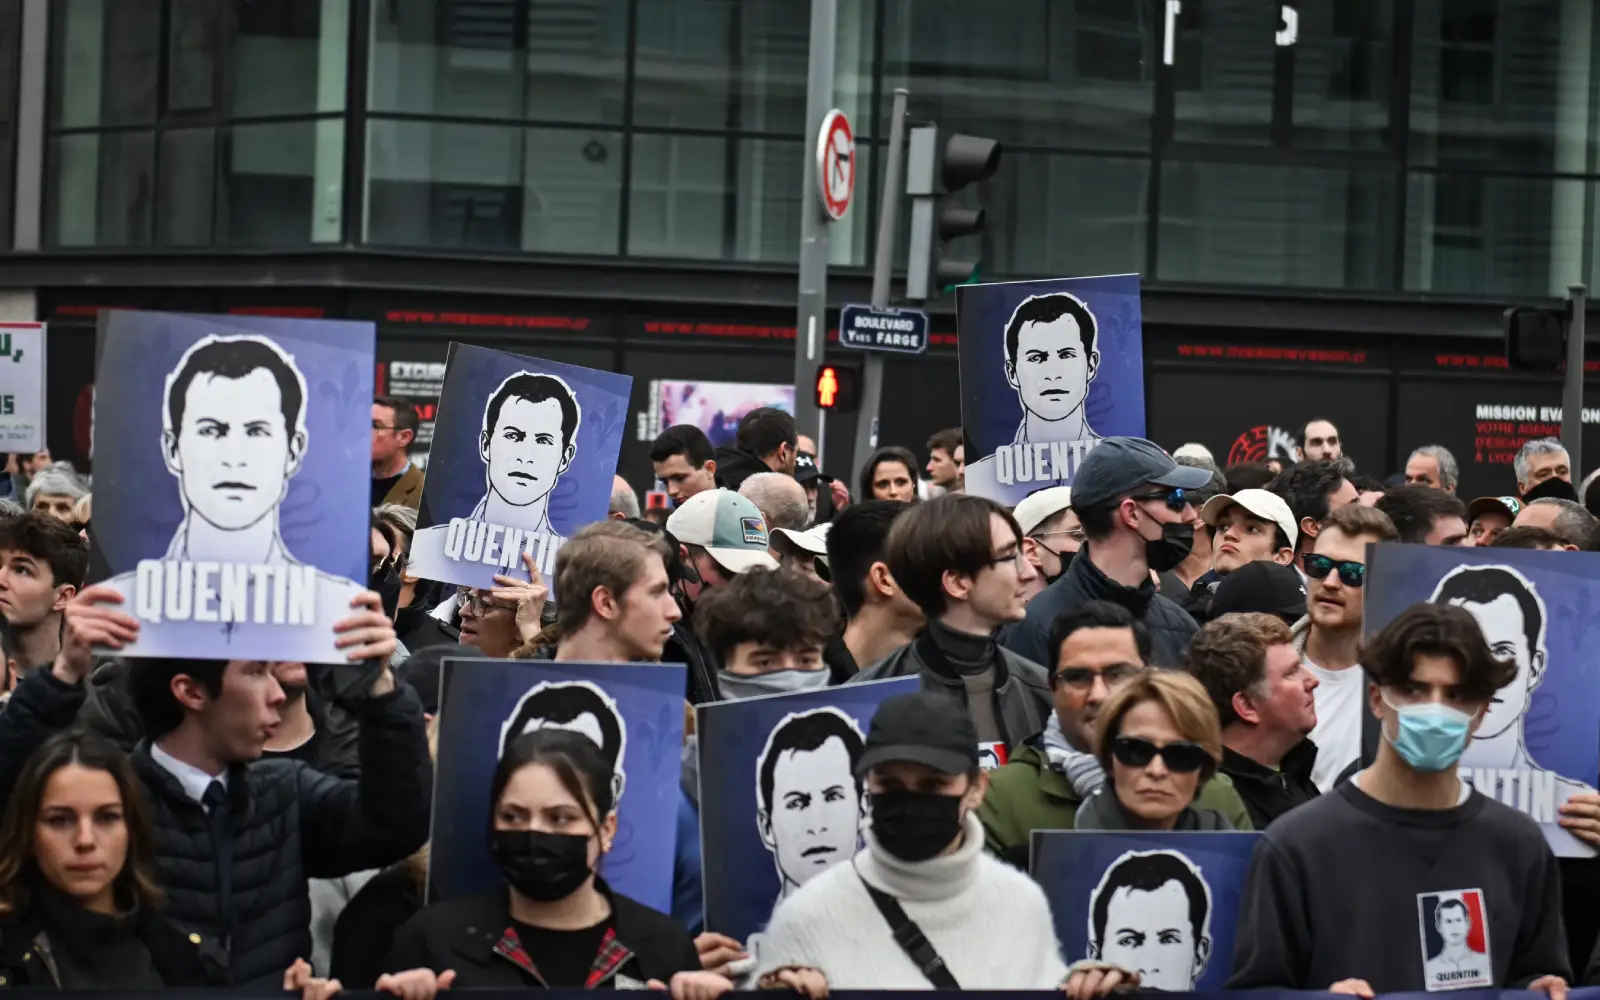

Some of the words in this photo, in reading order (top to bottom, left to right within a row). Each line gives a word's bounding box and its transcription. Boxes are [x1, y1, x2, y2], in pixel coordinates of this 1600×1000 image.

[854, 316, 914, 332] BOULEVARD
[876, 331, 919, 347] FARGE
[1476, 405, 1537, 421] MISSION
[996, 440, 1101, 485] QUENT
[136, 559, 317, 625] QUENTIN
[1436, 969, 1479, 982] QUENTIN
